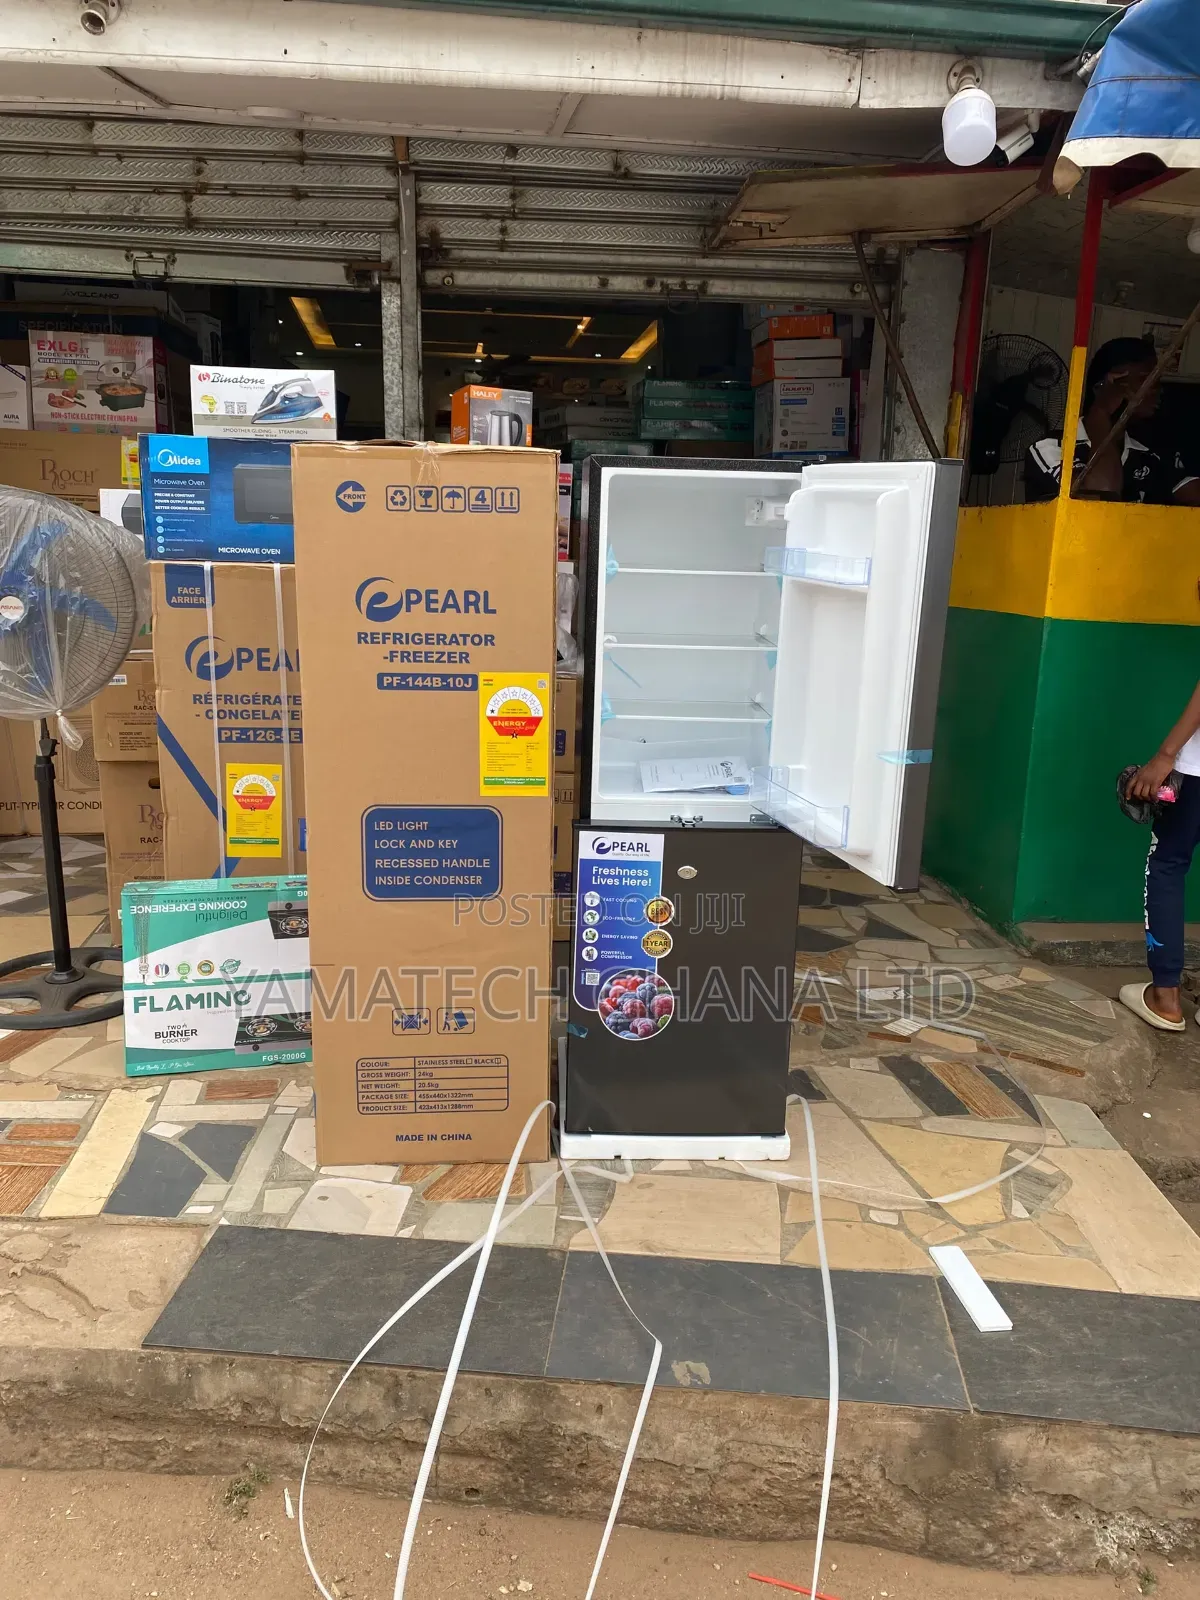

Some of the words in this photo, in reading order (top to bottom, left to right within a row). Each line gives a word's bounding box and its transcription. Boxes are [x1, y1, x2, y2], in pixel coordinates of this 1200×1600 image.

[18, 320, 123, 333] SPECIFICATION
[36, 339, 79, 353] EXLG
[210, 372, 266, 385] Binatone
[473, 390, 498, 398] HALEY
[50, 411, 80, 420] NON-STICK
[80, 413, 107, 422] ELECTRIC
[126, 415, 138, 423] PAN
[159, 450, 201, 467] Midea
[153, 478, 188, 486] Microwave
[177, 586, 201, 595] FACE
[405, 588, 497, 615] PEARL
[356, 631, 496, 646] REFRIGERATOR
[236, 647, 301, 673] PEA
[382, 650, 471, 664] -FREEZER
[383, 676, 473, 689] PF-144B-10J
[492, 720, 527, 728] ENERGY
[0, 801, 40, 810] PLIT-TYP
[374, 821, 394, 831] LED
[397, 821, 429, 831] LIGHT
[374, 839, 406, 849] LOCK
[409, 839, 435, 849] AND
[438, 839, 459, 849] KEY
[612, 841, 651, 853] PEARL
[375, 858, 439, 869] RECESSED
[442, 858, 491, 868] HANDLE
[592, 865, 649, 877] Freshness
[375, 875, 411, 886] INSIDE
[414, 875, 483, 885] CONDENSER
[592, 875, 620, 886] Lives
[622, 877, 652, 887] Here!
[130, 900, 196, 914] EXPERIENCE
[199, 900, 248, 911] COOKING
[195, 910, 248, 923] Delightful
[154, 1028, 198, 1040] BURNER
[262, 1052, 306, 1062] FGS-2000G
[395, 1134, 424, 1142] MADE
[427, 1133, 438, 1141] IN
[440, 1133, 473, 1141] CHINA
